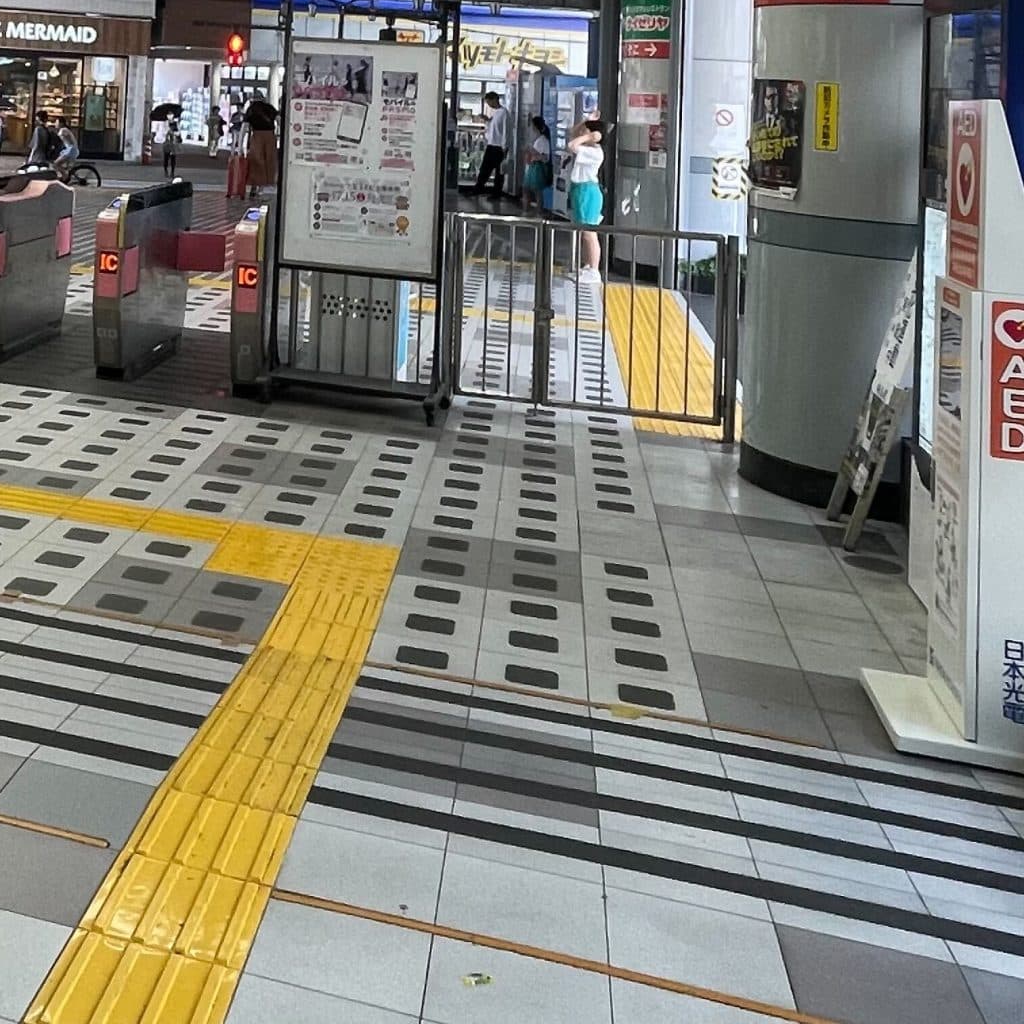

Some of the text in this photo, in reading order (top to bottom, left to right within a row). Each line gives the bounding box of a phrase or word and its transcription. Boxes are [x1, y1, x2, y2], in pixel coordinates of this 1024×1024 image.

[6, 21, 98, 44] MERMAID
[100, 253, 118, 271] IC
[238, 267, 258, 285] IC
